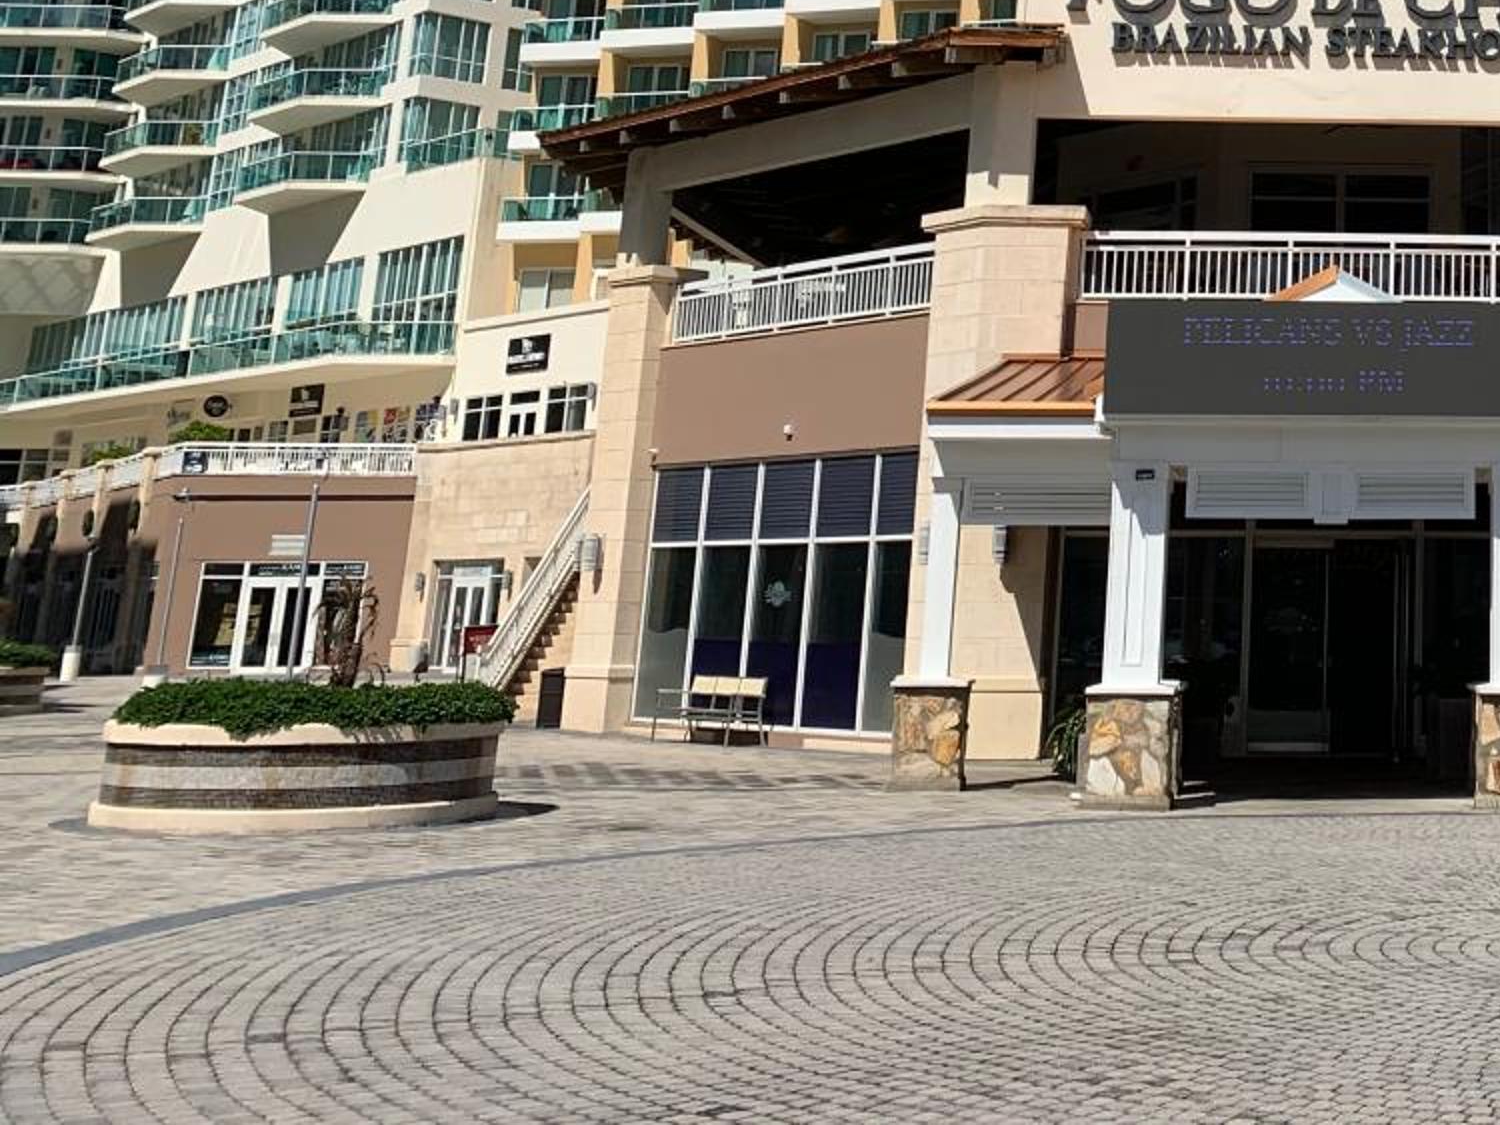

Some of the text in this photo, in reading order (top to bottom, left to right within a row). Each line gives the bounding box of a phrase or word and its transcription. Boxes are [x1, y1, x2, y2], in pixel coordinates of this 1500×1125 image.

[1111, 21, 1311, 58] BRAZILIAN
[1183, 316, 1475, 351] PELICANS VS JAZZ
